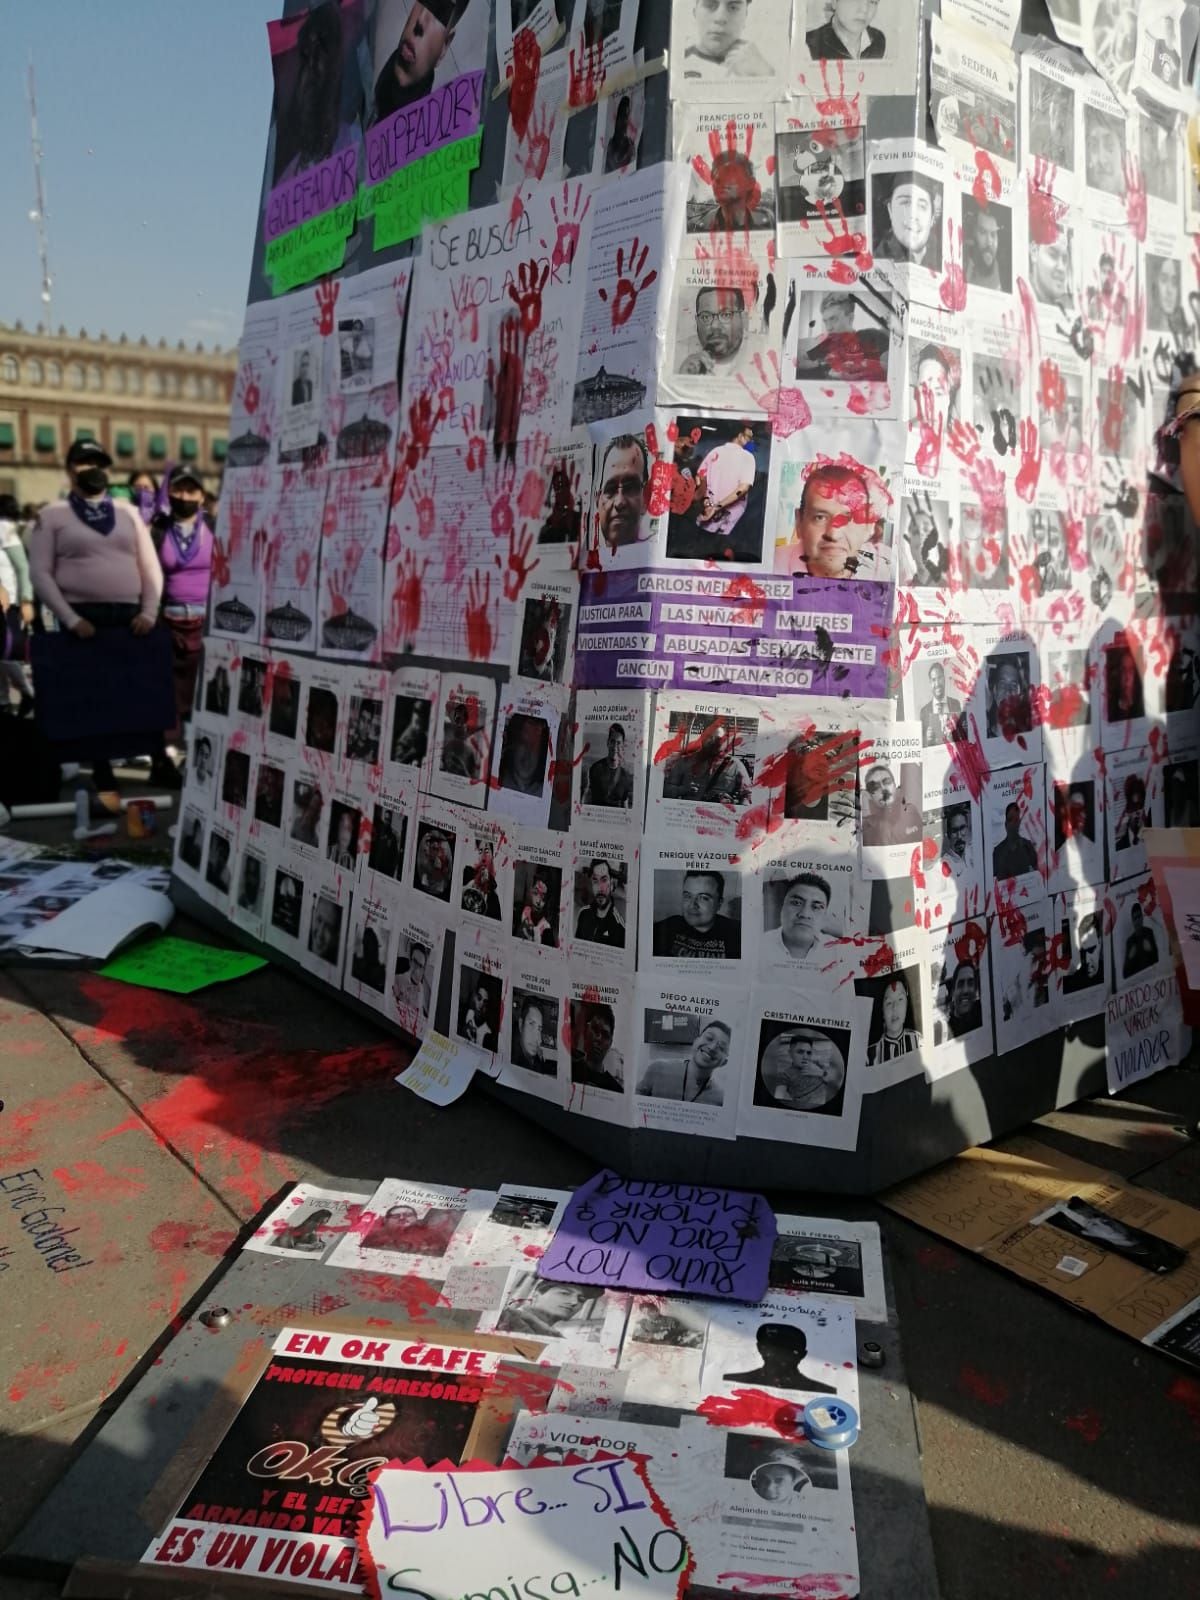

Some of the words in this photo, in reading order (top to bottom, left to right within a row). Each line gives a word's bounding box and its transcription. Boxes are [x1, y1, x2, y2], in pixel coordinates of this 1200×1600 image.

[961, 55, 998, 82] SEDENA
[699, 113, 750, 121] FRANCISCO
[753, 112, 764, 120] DE
[873, 151, 899, 161] KEVIN
[466, 210, 533, 262] BUSCA
[692, 268, 711, 276] LUIS
[639, 577, 692, 592] CARLOS
[580, 606, 617, 620] JUSTICIA
[618, 606, 643, 620] PARA
[667, 607, 693, 621] LAS
[698, 606, 744, 623] NIÑAS
[778, 615, 849, 631] MUJERES
[579, 636, 639, 651] VIOLENTADAS
[641, 636, 650, 649] Y
[667, 638, 749, 653] ABUSADAS
[760, 642, 873, 662] SEXUALENTE
[618, 660, 669, 677] CANCÚN
[687, 663, 769, 683] QUINTANA
[775, 669, 809, 685] ROO
[695, 705, 720, 713] ERICK
[892, 738, 920, 748] RODRIGO
[924, 786, 949, 799] ANTONIO
[599, 842, 625, 851] ANTONIO
[659, 852, 697, 860] ENRIQUE
[685, 860, 710, 869] PÉREZ
[766, 859, 788, 868] JOSÉ
[790, 861, 814, 870] CRUZ
[816, 863, 853, 872] SOLANO
[660, 992, 687, 1001] DIEGO
[689, 996, 720, 1007] ALEXIS
[1107, 983, 1152, 1024] RICARDO
[665, 1002, 692, 1013] GAMA
[694, 1006, 713, 1016] RUIZ
[764, 1010, 804, 1023] CRISTIAN
[1124, 1003, 1161, 1038] VARGAS
[1114, 1030, 1171, 1082] VIOLADOR
[395, 1195, 435, 1206] HIDALGO
[426, 1193, 468, 1204] RODRIGO
[611, 1200, 717, 1227] MORIR
[587, 1219, 650, 1246] NO
[744, 1301, 797, 1312] OSWALDO
[285, 1333, 331, 1356] EN
[341, 1340, 391, 1362] OK
[400, 1342, 487, 1373] CAFE
[265, 1363, 366, 1391] PROTEGEN
[367, 1376, 486, 1403] AGRESORES
[572, 1460, 647, 1514] SI
[260, 1489, 275, 1505] Y
[282, 1492, 308, 1511] EL
[315, 1495, 356, 1515] JEF
[187, 1504, 305, 1531] ARMANDO
[729, 1505, 769, 1516] Alejandro
[771, 1509, 807, 1520] Saucedo
[154, 1526, 204, 1565] ES
[205, 1531, 257, 1570] UN
[613, 1526, 689, 1592] NO
